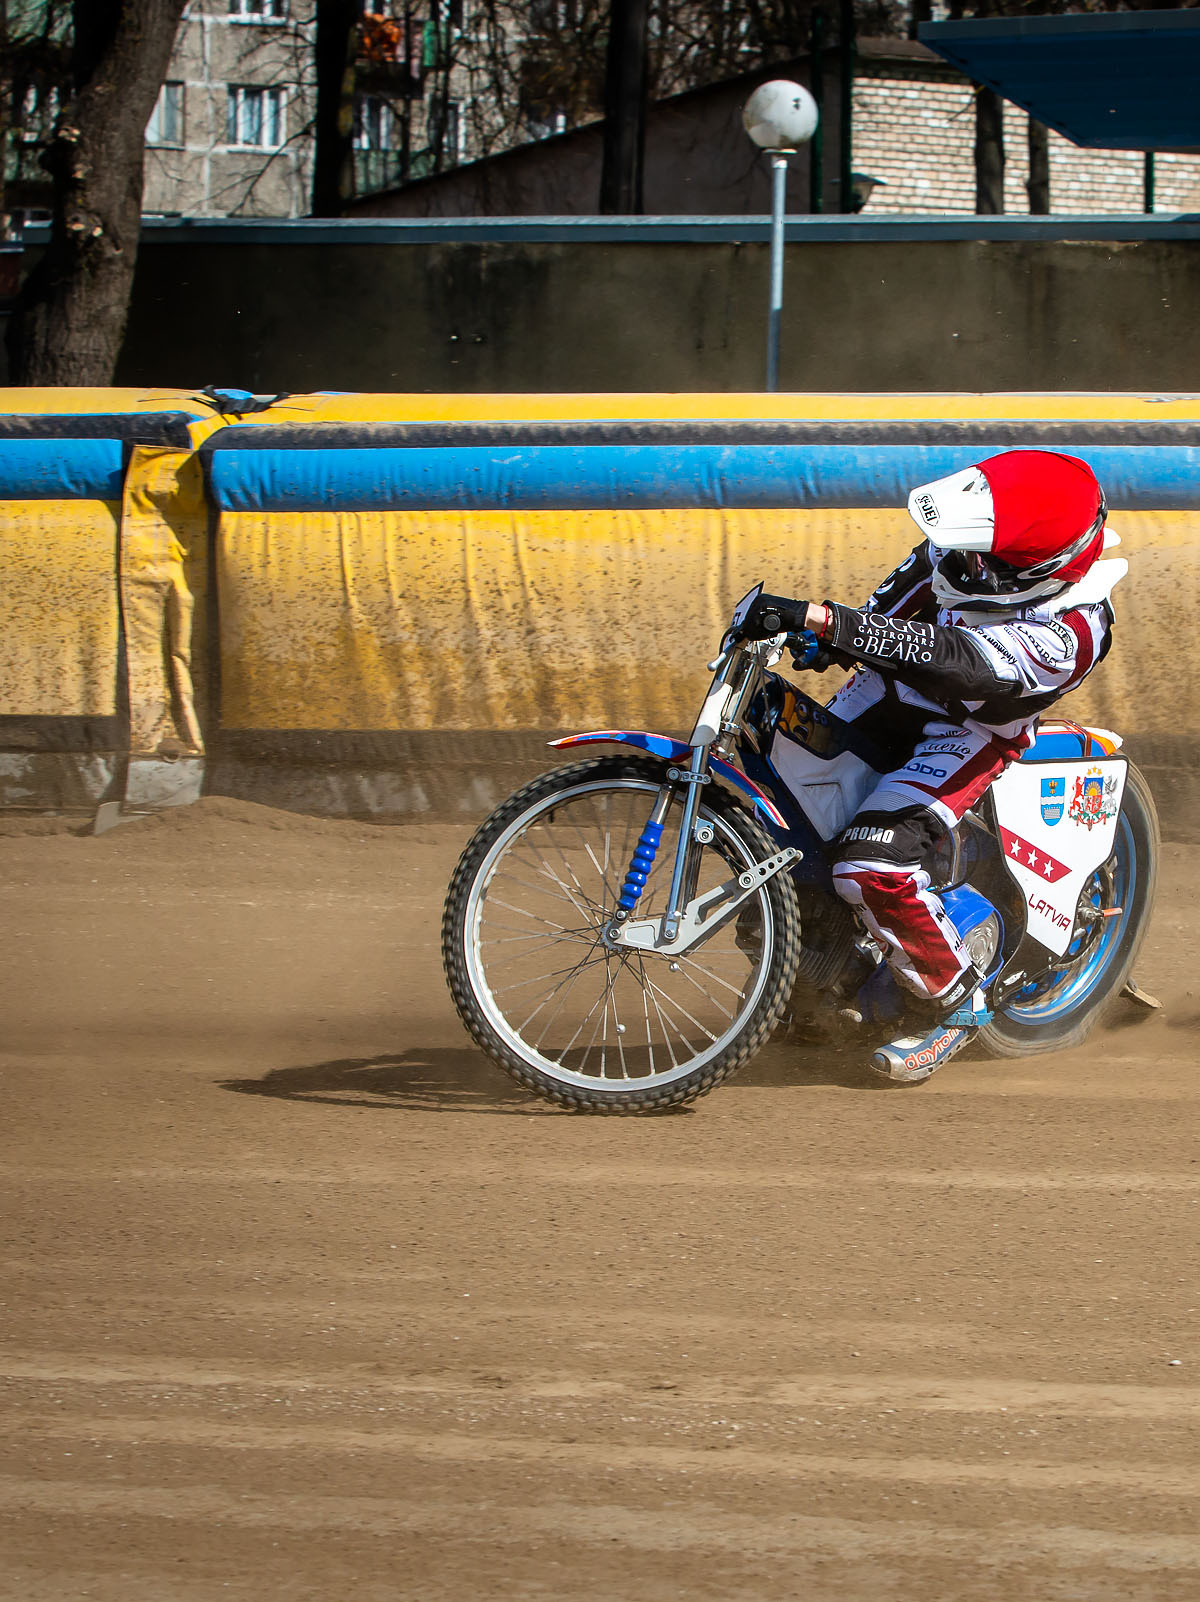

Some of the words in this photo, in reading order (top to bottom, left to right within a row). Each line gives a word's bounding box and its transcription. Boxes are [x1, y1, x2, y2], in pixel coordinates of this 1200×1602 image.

[856, 611, 935, 640] YOGGI
[863, 635, 921, 664] BEAR
[1028, 893, 1072, 931] LATVIA
[904, 1027, 963, 1071] dayton
